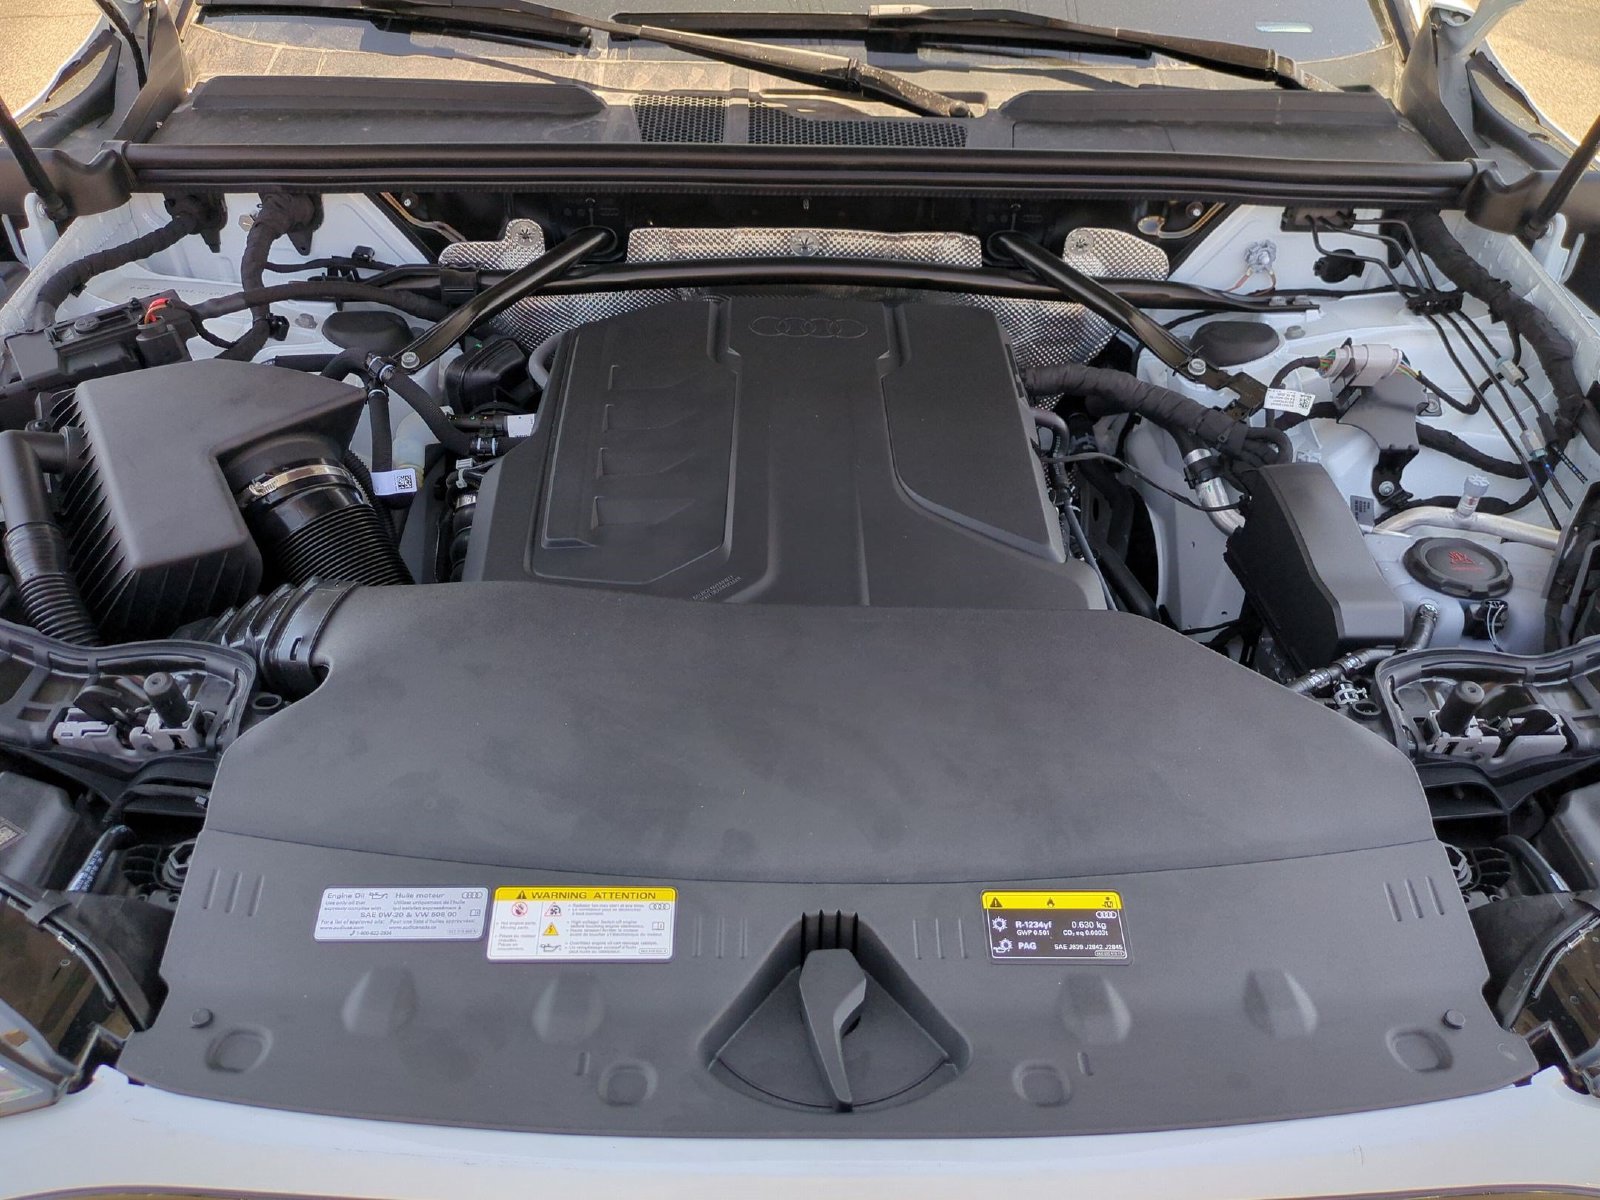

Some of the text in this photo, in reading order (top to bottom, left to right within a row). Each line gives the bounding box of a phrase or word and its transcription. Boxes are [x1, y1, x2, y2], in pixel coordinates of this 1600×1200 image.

[327, 892, 353, 900] Engine
[531, 891, 656, 900] WARNING ATTENTION
[1015, 920, 1107, 930] R-1234yf 0.630 kg
[1018, 942, 1037, 950] PAG
